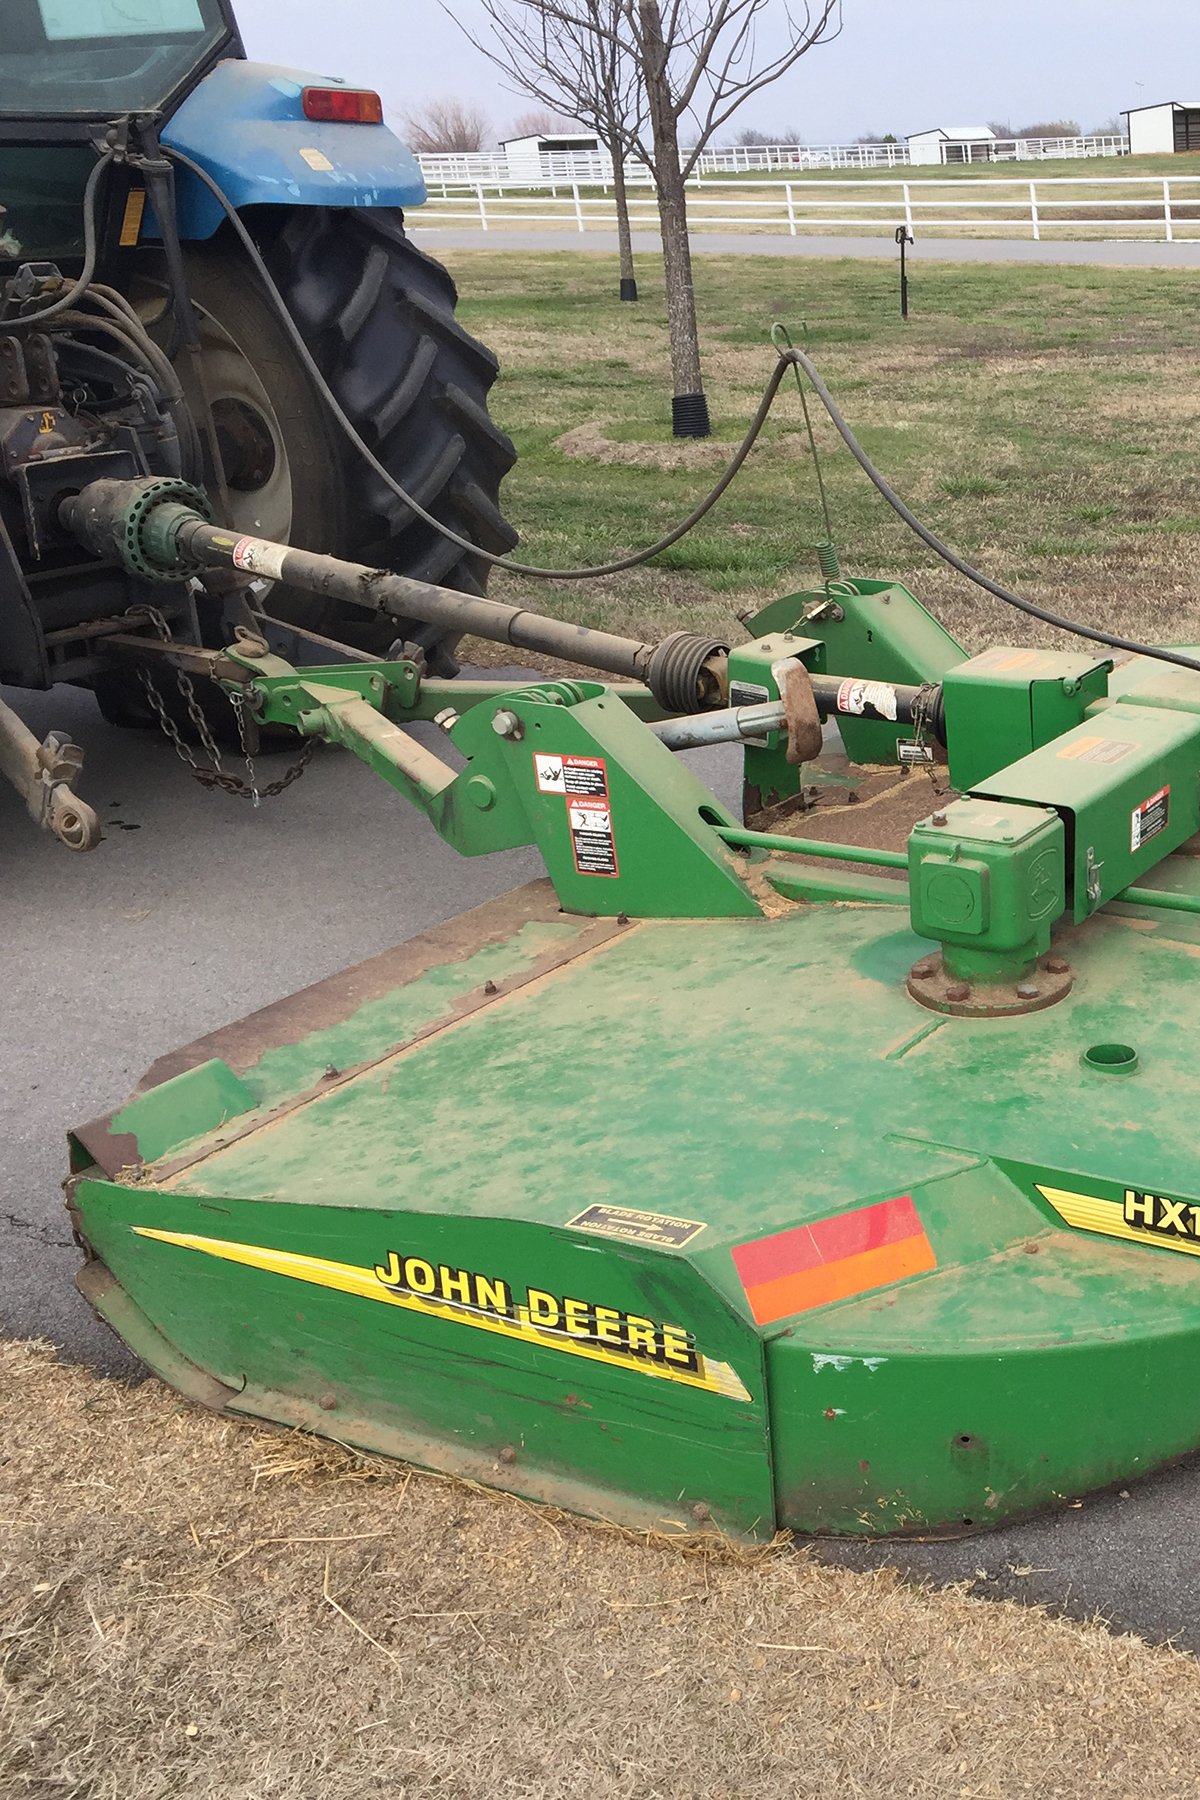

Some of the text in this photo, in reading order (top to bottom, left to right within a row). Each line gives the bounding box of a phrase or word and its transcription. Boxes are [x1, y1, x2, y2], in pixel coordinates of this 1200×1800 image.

[573, 758, 599, 767] DANGER
[579, 801, 606, 810] DANGER
[598, 1207, 692, 1230] BLADE ROTATION
[580, 1220, 676, 1243] BLADE ROTATION
[373, 1251, 692, 1365] JOHN DEERE
